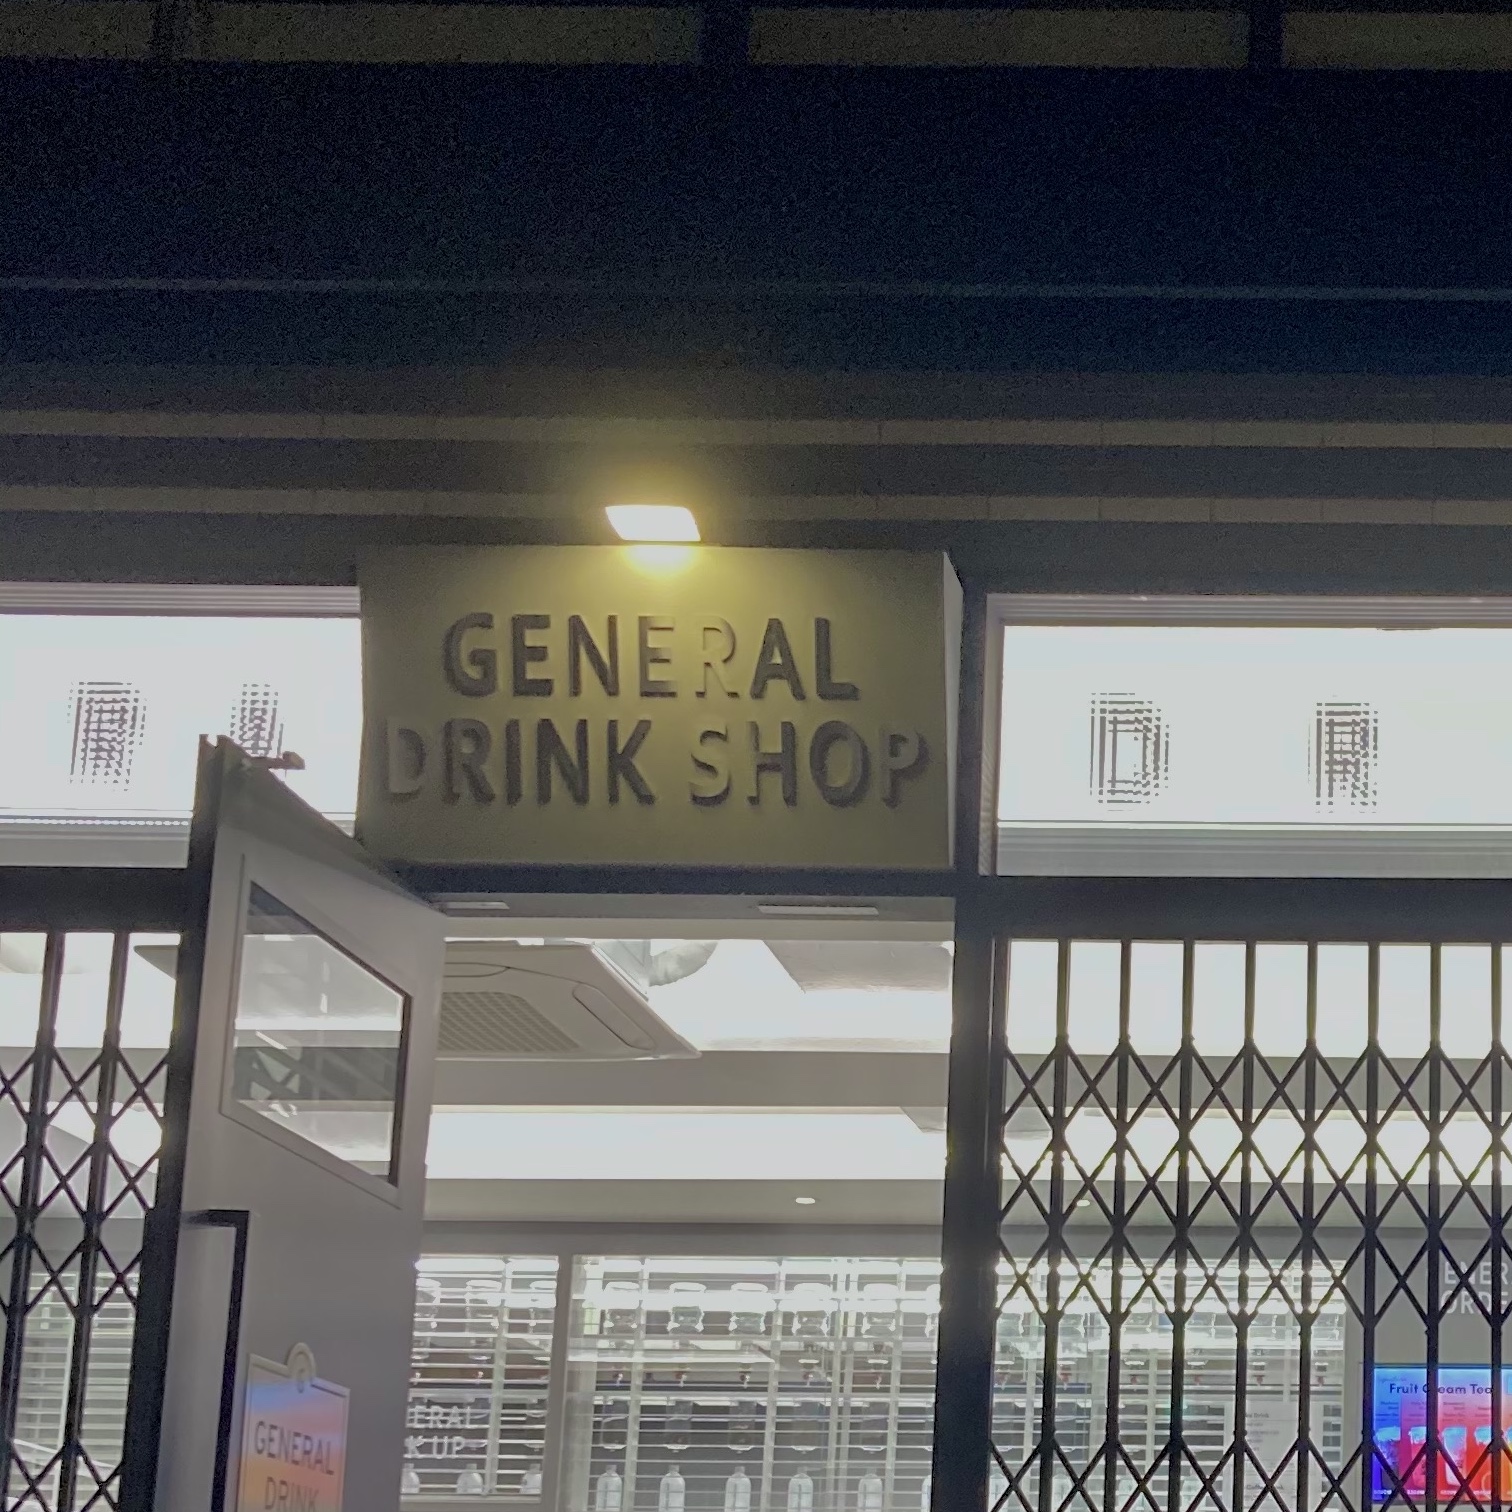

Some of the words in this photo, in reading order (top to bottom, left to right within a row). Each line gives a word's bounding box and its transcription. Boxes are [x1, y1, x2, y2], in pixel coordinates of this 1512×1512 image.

[441, 612, 861, 701] GENERAL
[384, 717, 656, 806] DRINK
[688, 718, 931, 808] SHOP
[1389, 1382, 1419, 1394] Fruit
[1422, 1383, 1467, 1394] Ceam
[1471, 1383, 1494, 1394] Tea
[254, 1420, 335, 1475] GENERAL
